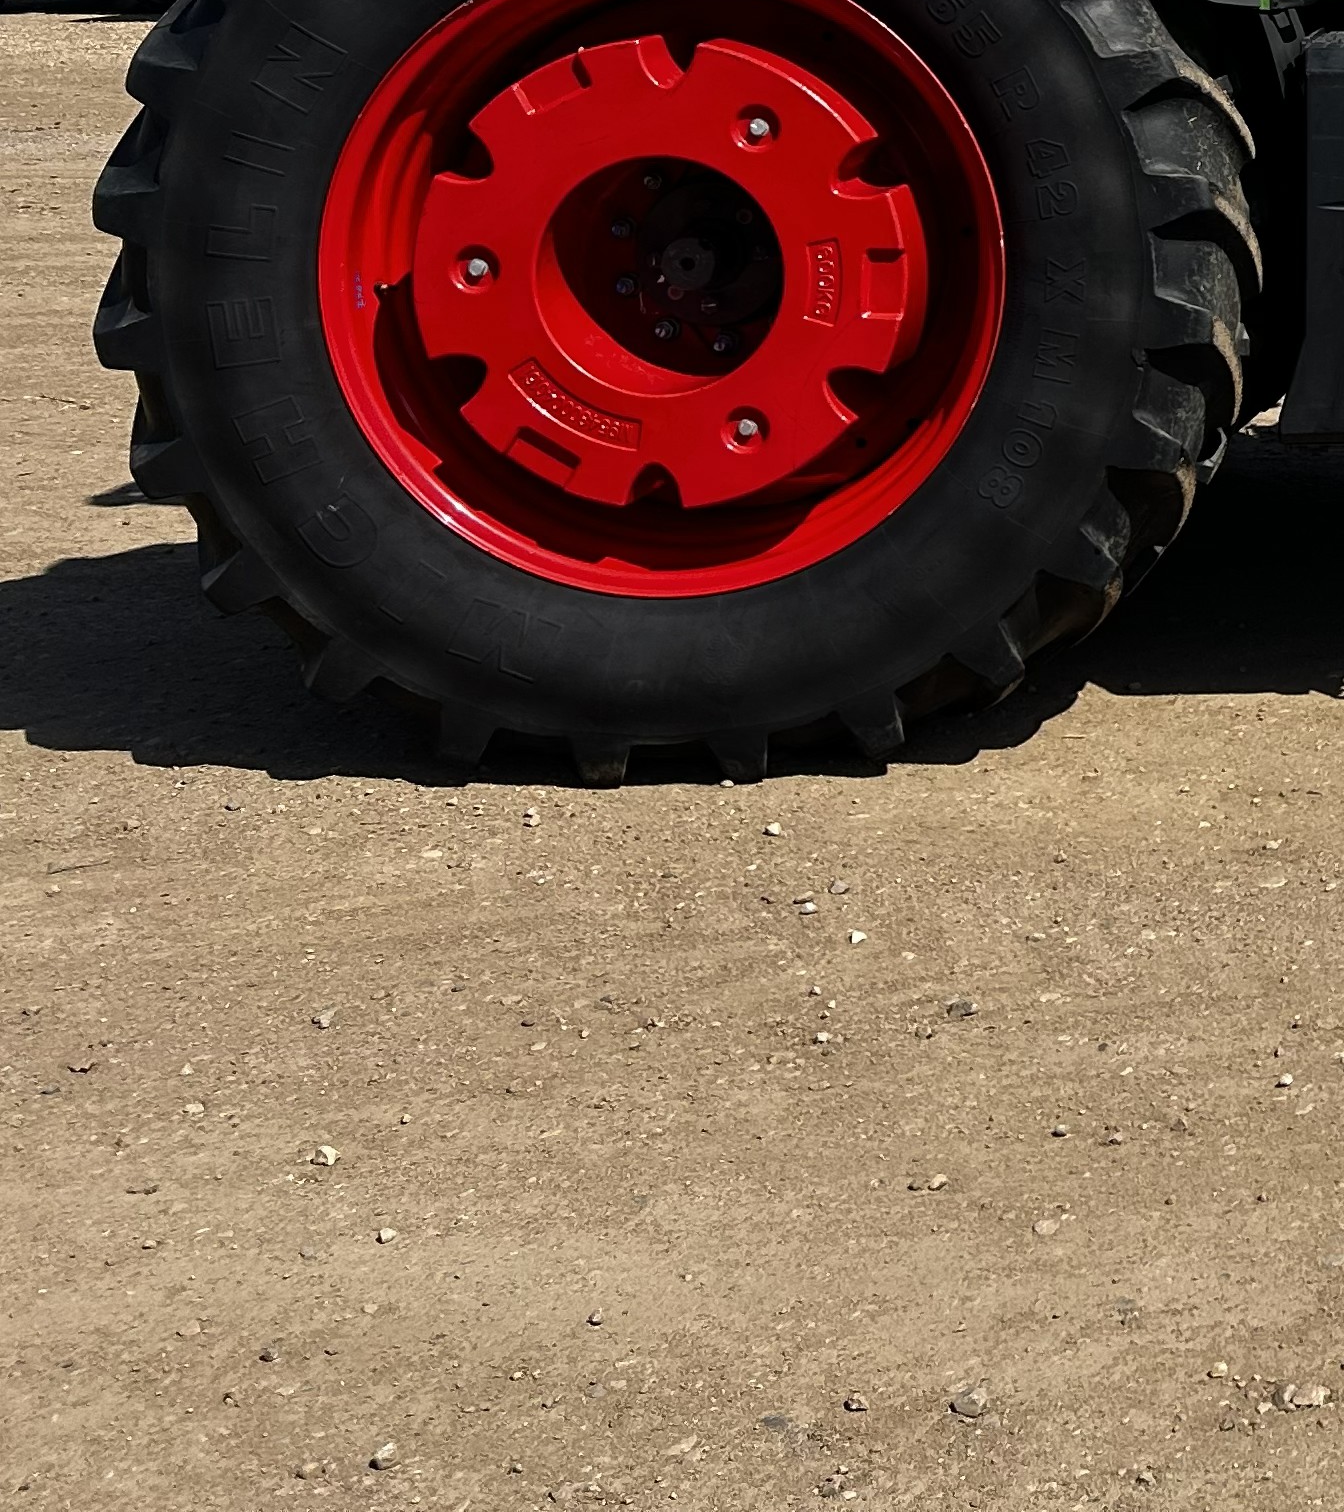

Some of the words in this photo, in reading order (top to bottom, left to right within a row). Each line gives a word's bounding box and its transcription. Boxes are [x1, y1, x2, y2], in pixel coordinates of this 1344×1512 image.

[989, 64, 1046, 121] R
[1021, 134, 1081, 220] 42
[206, 20, 560, 687] MICHELIN
